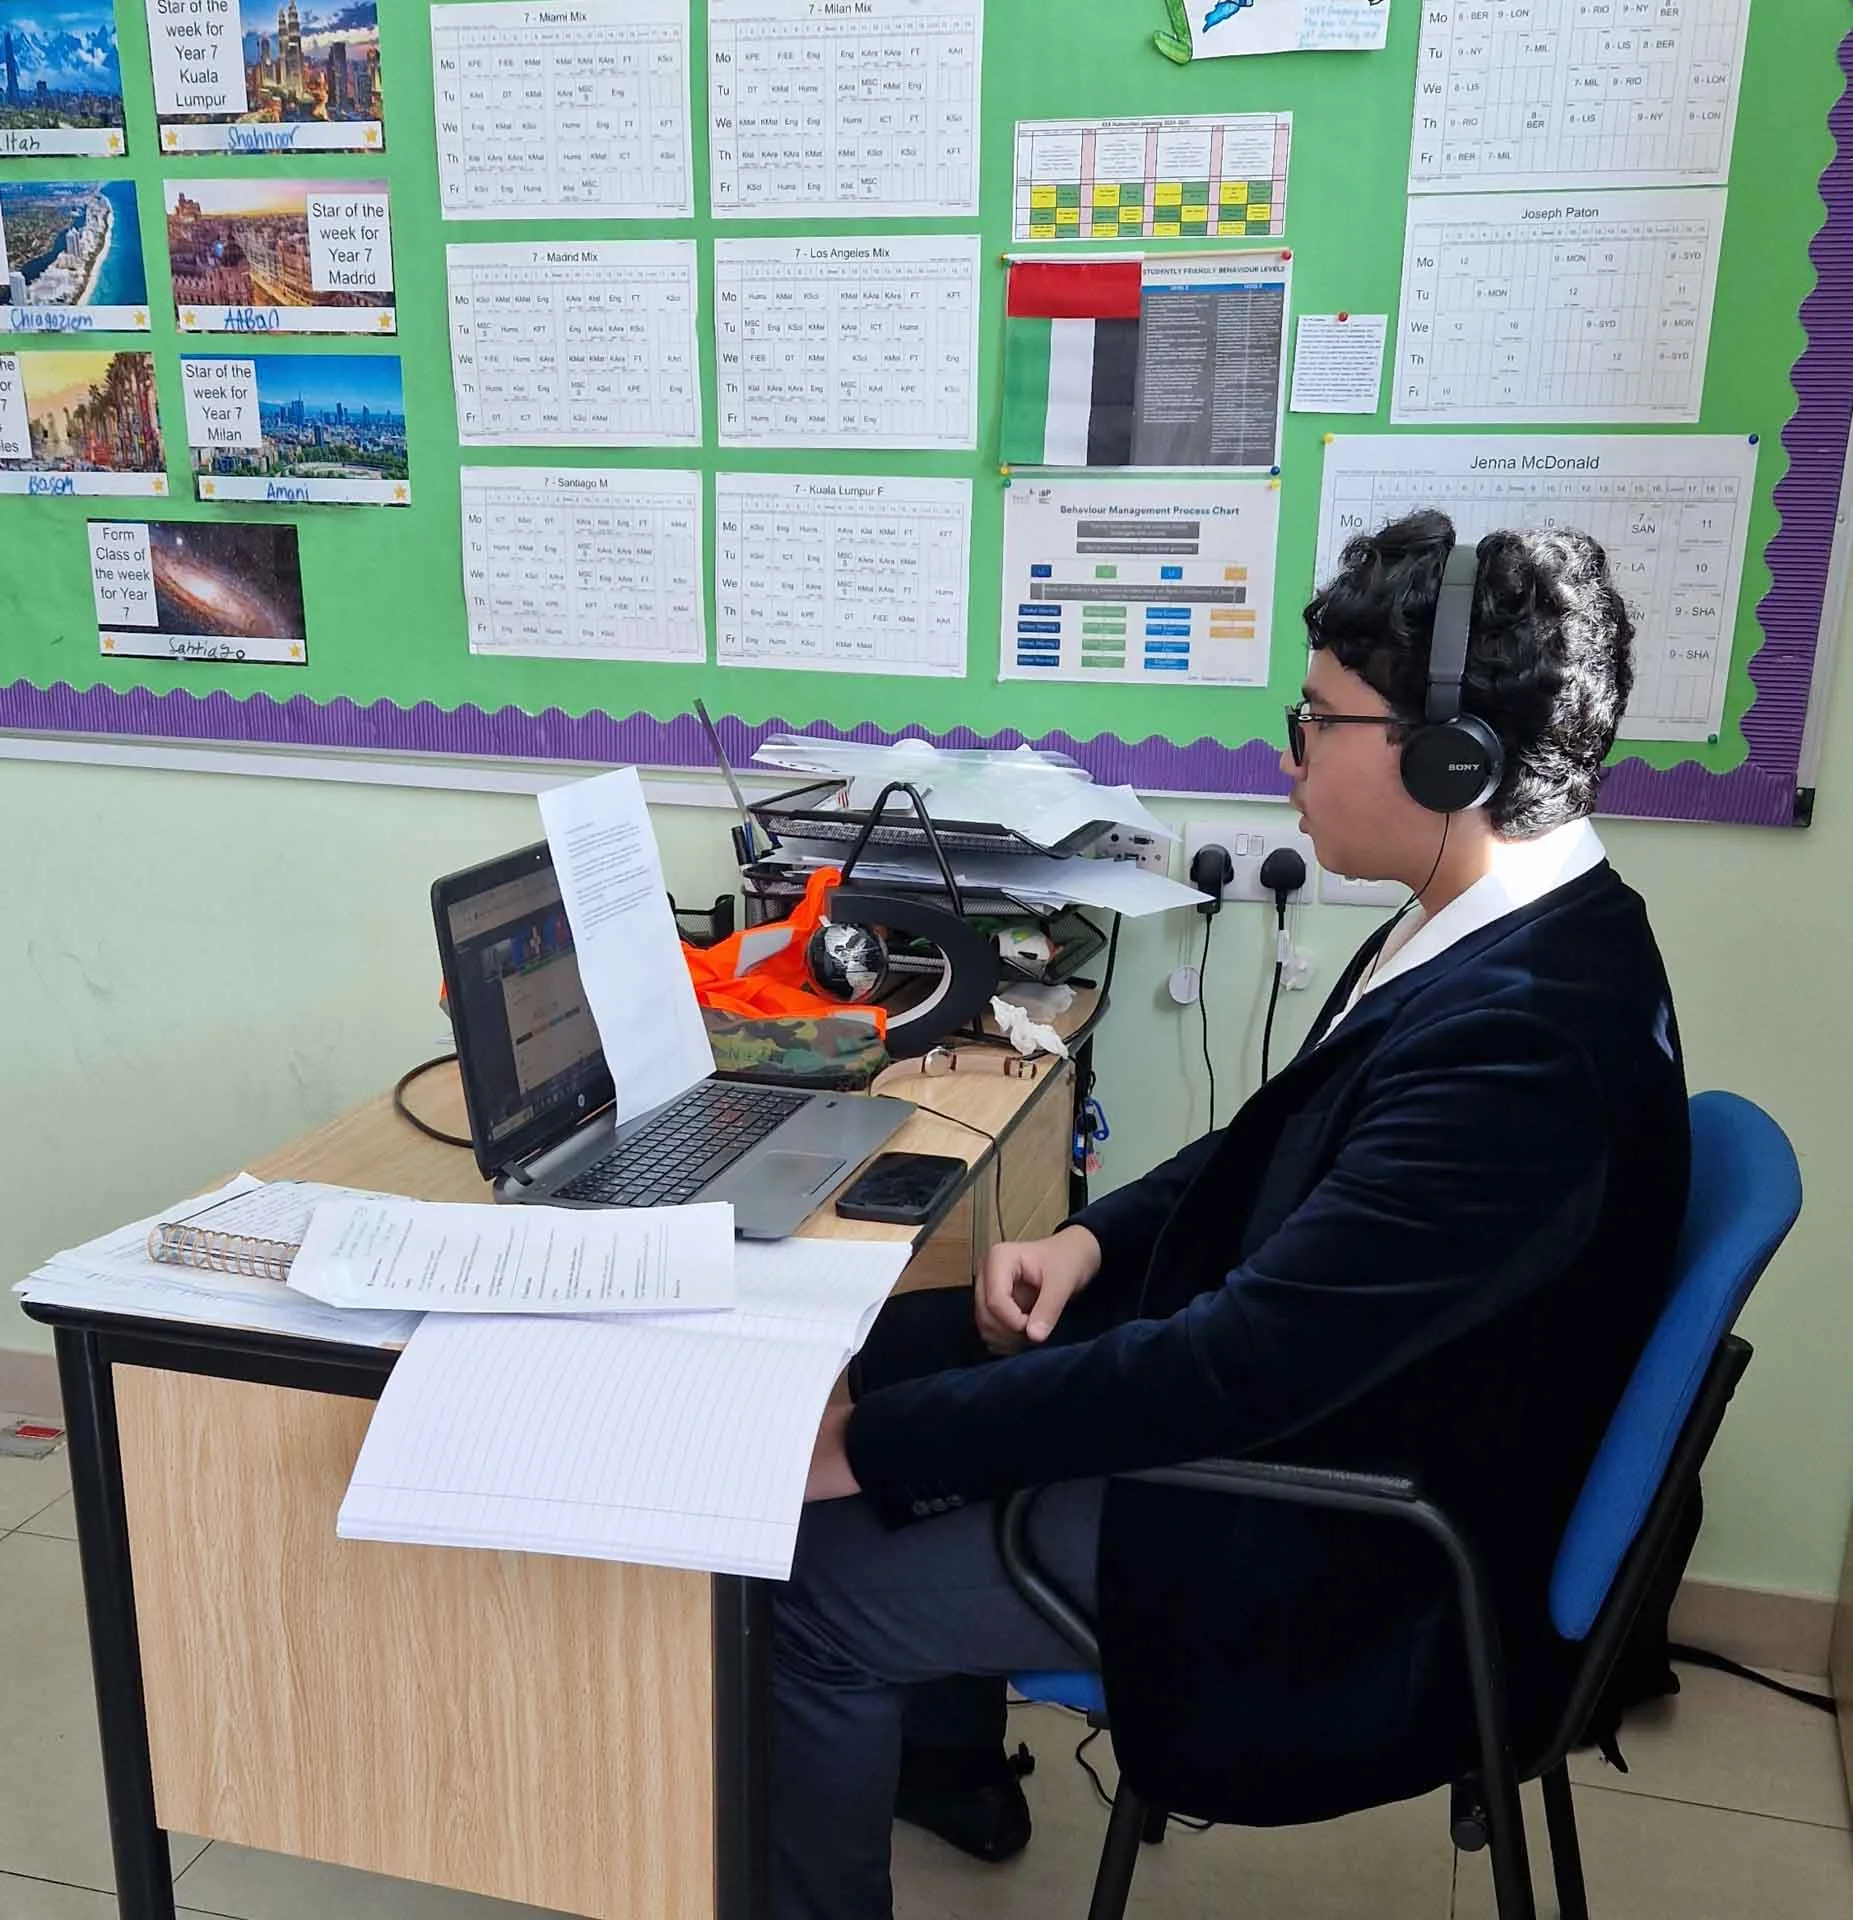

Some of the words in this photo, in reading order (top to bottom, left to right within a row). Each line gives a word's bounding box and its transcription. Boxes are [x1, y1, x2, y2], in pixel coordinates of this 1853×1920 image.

[157, 0, 188, 13] Star
[191, 0, 204, 13] of
[207, 0, 228, 13] the
[809, 5, 813, 14] 7
[825, 4, 851, 14] Milan
[855, 4, 872, 12] Mix
[1512, 9, 1529, 17] LON
[1660, 8, 1679, 16] BER
[525, 13, 529, 23] 7
[539, 13, 568, 23] Miami
[571, 13, 586, 21] Mix
[1429, 12, 1448, 23] Mo
[166, 22, 201, 37] week
[206, 22, 223, 37] for
[176, 45, 206, 60] Year
[210, 45, 217, 60] 7
[1428, 48, 1442, 58] Tu
[716, 53, 731, 63] Mo
[441, 60, 455, 70] Mo
[180, 70, 218, 83] Kuala
[718, 86, 729, 95] Tu
[1423, 83, 1442, 94] We
[176, 93, 226, 108] Lumpur
[444, 92, 455, 101] Tu
[443, 124, 458, 132] We
[716, 119, 732, 128] We
[1423, 118, 1437, 128] Th
[1527, 119, 1544, 128] BER
[448, 154, 458, 163] Th
[719, 151, 731, 160] Th
[1421, 153, 1432, 164] Fr
[450, 185, 459, 193] Fr
[721, 183, 731, 192] Fr
[312, 203, 341, 218] Star
[344, 203, 358, 217] of
[360, 203, 384, 218] the
[1521, 208, 1561, 220] Joseph
[1566, 207, 1599, 218] Paton
[320, 226, 355, 240] week
[360, 226, 379, 240] for
[329, 249, 360, 263] Year
[364, 249, 371, 262] 7
[533, 253, 537, 262] 7
[547, 253, 578, 262] Madrid
[582, 253, 598, 262] Mix
[795, 249, 800, 258] 7
[810, 249, 828, 258] Los
[831, 249, 869, 260] Angeles
[873, 249, 889, 257] Mix
[1417, 257, 1433, 267] Mo
[329, 271, 375, 285] Madrid
[1416, 290, 1429, 300] Tu
[1569, 287, 1577, 295] 12
[455, 296, 469, 304] Mo
[722, 292, 736, 301] Mo
[458, 326, 469, 334] Tu
[724, 323, 736, 332] Tu
[1411, 322, 1429, 332] We
[458, 355, 473, 363] We
[723, 354, 738, 363] We
[1410, 355, 1424, 364] Th
[185, 364, 211, 378] Star
[215, 364, 227, 377] of
[231, 364, 251, 378] the
[0, 380, 11, 392] or
[463, 384, 474, 392] Th
[726, 384, 738, 392] Th
[1409, 386, 1419, 396] Fr
[194, 386, 226, 399] week
[231, 386, 247, 399] for
[2, 399, 7, 410] 7
[201, 407, 231, 420] Year
[235, 407, 242, 420] 7
[466, 413, 476, 421] Fr
[728, 414, 737, 423] Fr
[208, 428, 241, 441] Milan
[1471, 456, 1517, 469] Jenna
[1521, 455, 1599, 469] McDonald
[544, 478, 548, 486] 7
[558, 479, 596, 489] Santiago
[600, 479, 608, 488] M
[266, 484, 309, 501] Amani
[795, 485, 800, 494] 7
[810, 486, 836, 495] Kuala
[839, 486, 875, 498] Lumpur
[878, 488, 884, 496] F
[1060, 505, 1106, 515] Behaviour
[1109, 505, 1170, 516] Management
[1173, 506, 1210, 515] Process
[1212, 507, 1239, 515] Chart
[469, 515, 482, 524] Mo
[1340, 515, 1362, 527] Mo
[1702, 520, 1712, 528] 11
[723, 523, 737, 531] Mo
[1632, 524, 1655, 534] SAN
[103, 528, 135, 541] Form
[472, 543, 481, 551] Tu
[96, 548, 131, 561] Class
[134, 548, 145, 560] of
[725, 551, 735, 560] Tu
[1631, 563, 1645, 572] LA
[1696, 563, 1708, 572] 10
[95, 569, 114, 581] the
[117, 569, 150, 581] week
[470, 570, 484, 578] We
[723, 580, 737, 588] We
[100, 588, 117, 600] for
[120, 589, 148, 601] Year
[474, 598, 485, 606] Th
[122, 607, 130, 618] 7
[724, 607, 736, 616] Th
[1675, 608, 1682, 616] 9
[1692, 607, 1715, 616] SHA
[478, 624, 486, 632] Fr
[726, 635, 735, 643] Fr
[1686, 651, 1709, 659] SHA
